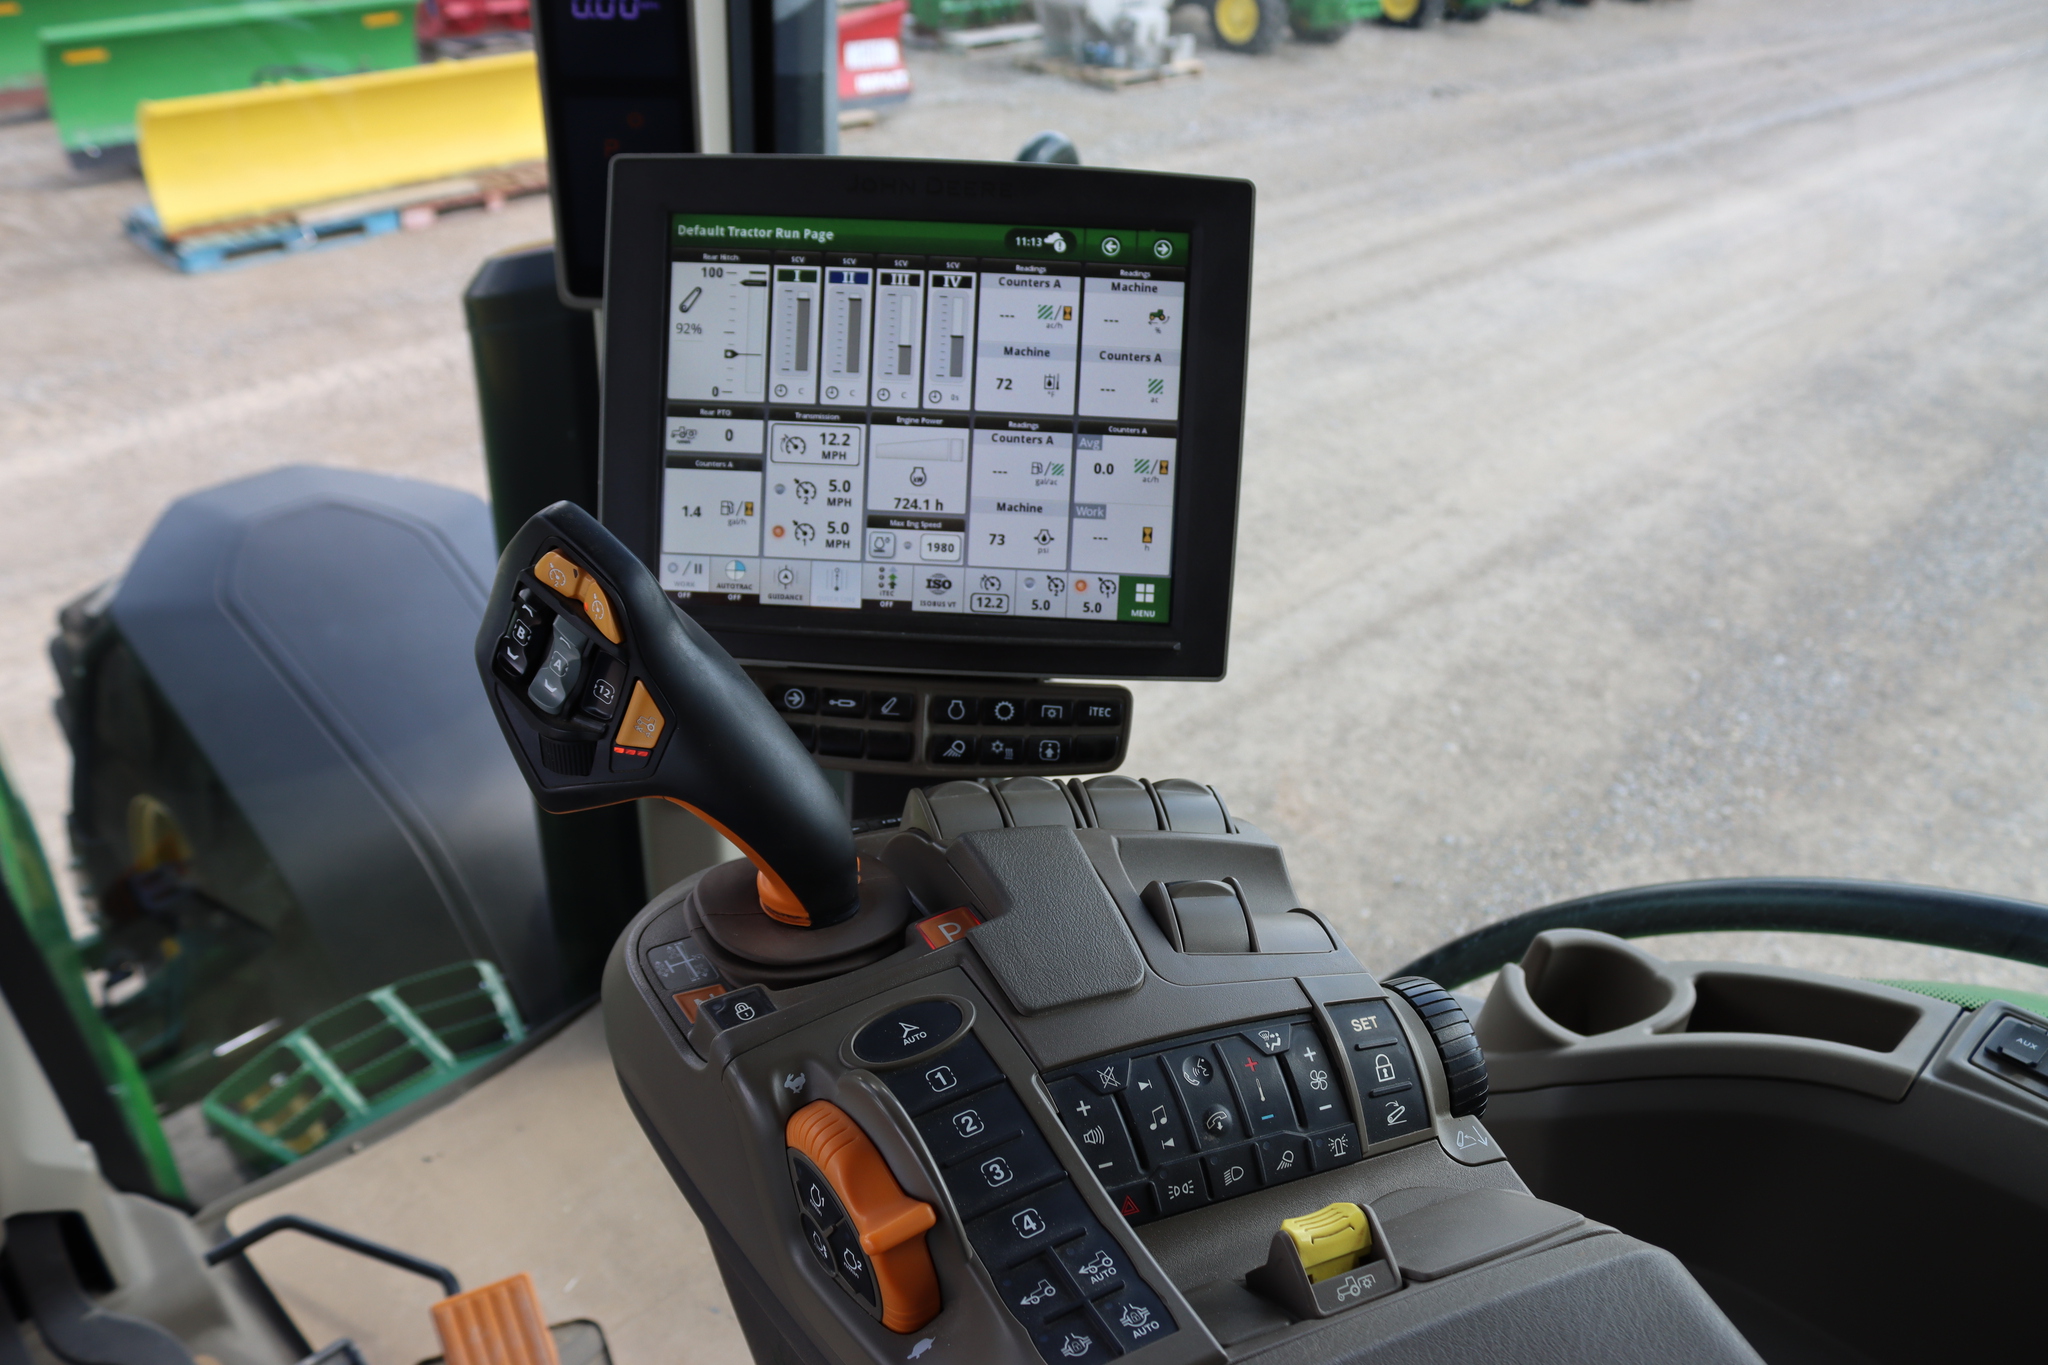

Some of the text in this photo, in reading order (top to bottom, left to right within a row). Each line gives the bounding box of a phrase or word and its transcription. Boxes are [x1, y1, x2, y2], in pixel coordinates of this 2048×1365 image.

[845, 174, 1013, 199] JOHN DEERE
[678, 225, 834, 244] Default Tractor Run Page
[1016, 236, 1042, 247] 11:13
[946, 261, 960, 269] SCV
[1015, 264, 1046, 274] Readings
[701, 267, 723, 278] 100
[842, 271, 855, 283] II
[1120, 269, 1151, 278] Readings
[891, 273, 909, 285] III
[943, 276, 961, 287] IV
[999, 277, 1061, 288] Counters A
[1111, 282, 1158, 293] Machine
[676, 323, 702, 335] 92%
[1004, 346, 1050, 357] Machine
[1099, 351, 1162, 363] Counters A
[996, 378, 1012, 390] 72
[712, 386, 719, 397] 0
[795, 412, 840, 421] Transmission
[896, 416, 943, 426] Engine Power
[1008, 421, 1039, 430] Readings
[1108, 426, 1140, 434] Counters
[725, 429, 733, 441] 0
[819, 433, 850, 446] 12.2
[991, 433, 1054, 445] Counters A
[1079, 437, 1100, 450] Avg
[822, 451, 847, 460] MPH
[1094, 463, 1114, 475] 0.0
[829, 480, 851, 492] 5.0
[827, 498, 852, 507] MPH
[894, 498, 943, 511] 724.1 h
[997, 502, 1043, 513] Machine
[682, 506, 701, 517] 1.4
[1076, 506, 1104, 517] Work
[827, 522, 849, 534] 5.0
[907, 520, 919, 529] Eng
[921, 521, 942, 530] Speed
[826, 539, 850, 549] MPH
[989, 533, 1005, 546] 73
[927, 542, 954, 553] 1980
[926, 579, 952, 590] ISO
[768, 593, 803, 601] GUIDANCE
[976, 597, 1003, 609] 12.2
[1032, 600, 1050, 612] 5.0
[1083, 602, 1102, 614] 5.0
[1131, 610, 1155, 618] MENU
[517, 626, 525, 640] B
[553, 659, 562, 671] A
[598, 686, 611, 699] 12
[1089, 706, 1111, 718] iTEC
[938, 922, 961, 942] P
[1351, 1015, 1378, 1032] SET
[903, 1031, 927, 1046] AUTO
[2016, 1038, 2038, 1050] AUX
[934, 1072, 948, 1086] 1
[961, 1116, 975, 1132] 2
[990, 1164, 1005, 1180] 3
[1022, 1214, 1036, 1231] 4
[1090, 1266, 1117, 1284] AUTO
[1133, 1321, 1160, 1339] AUTO
